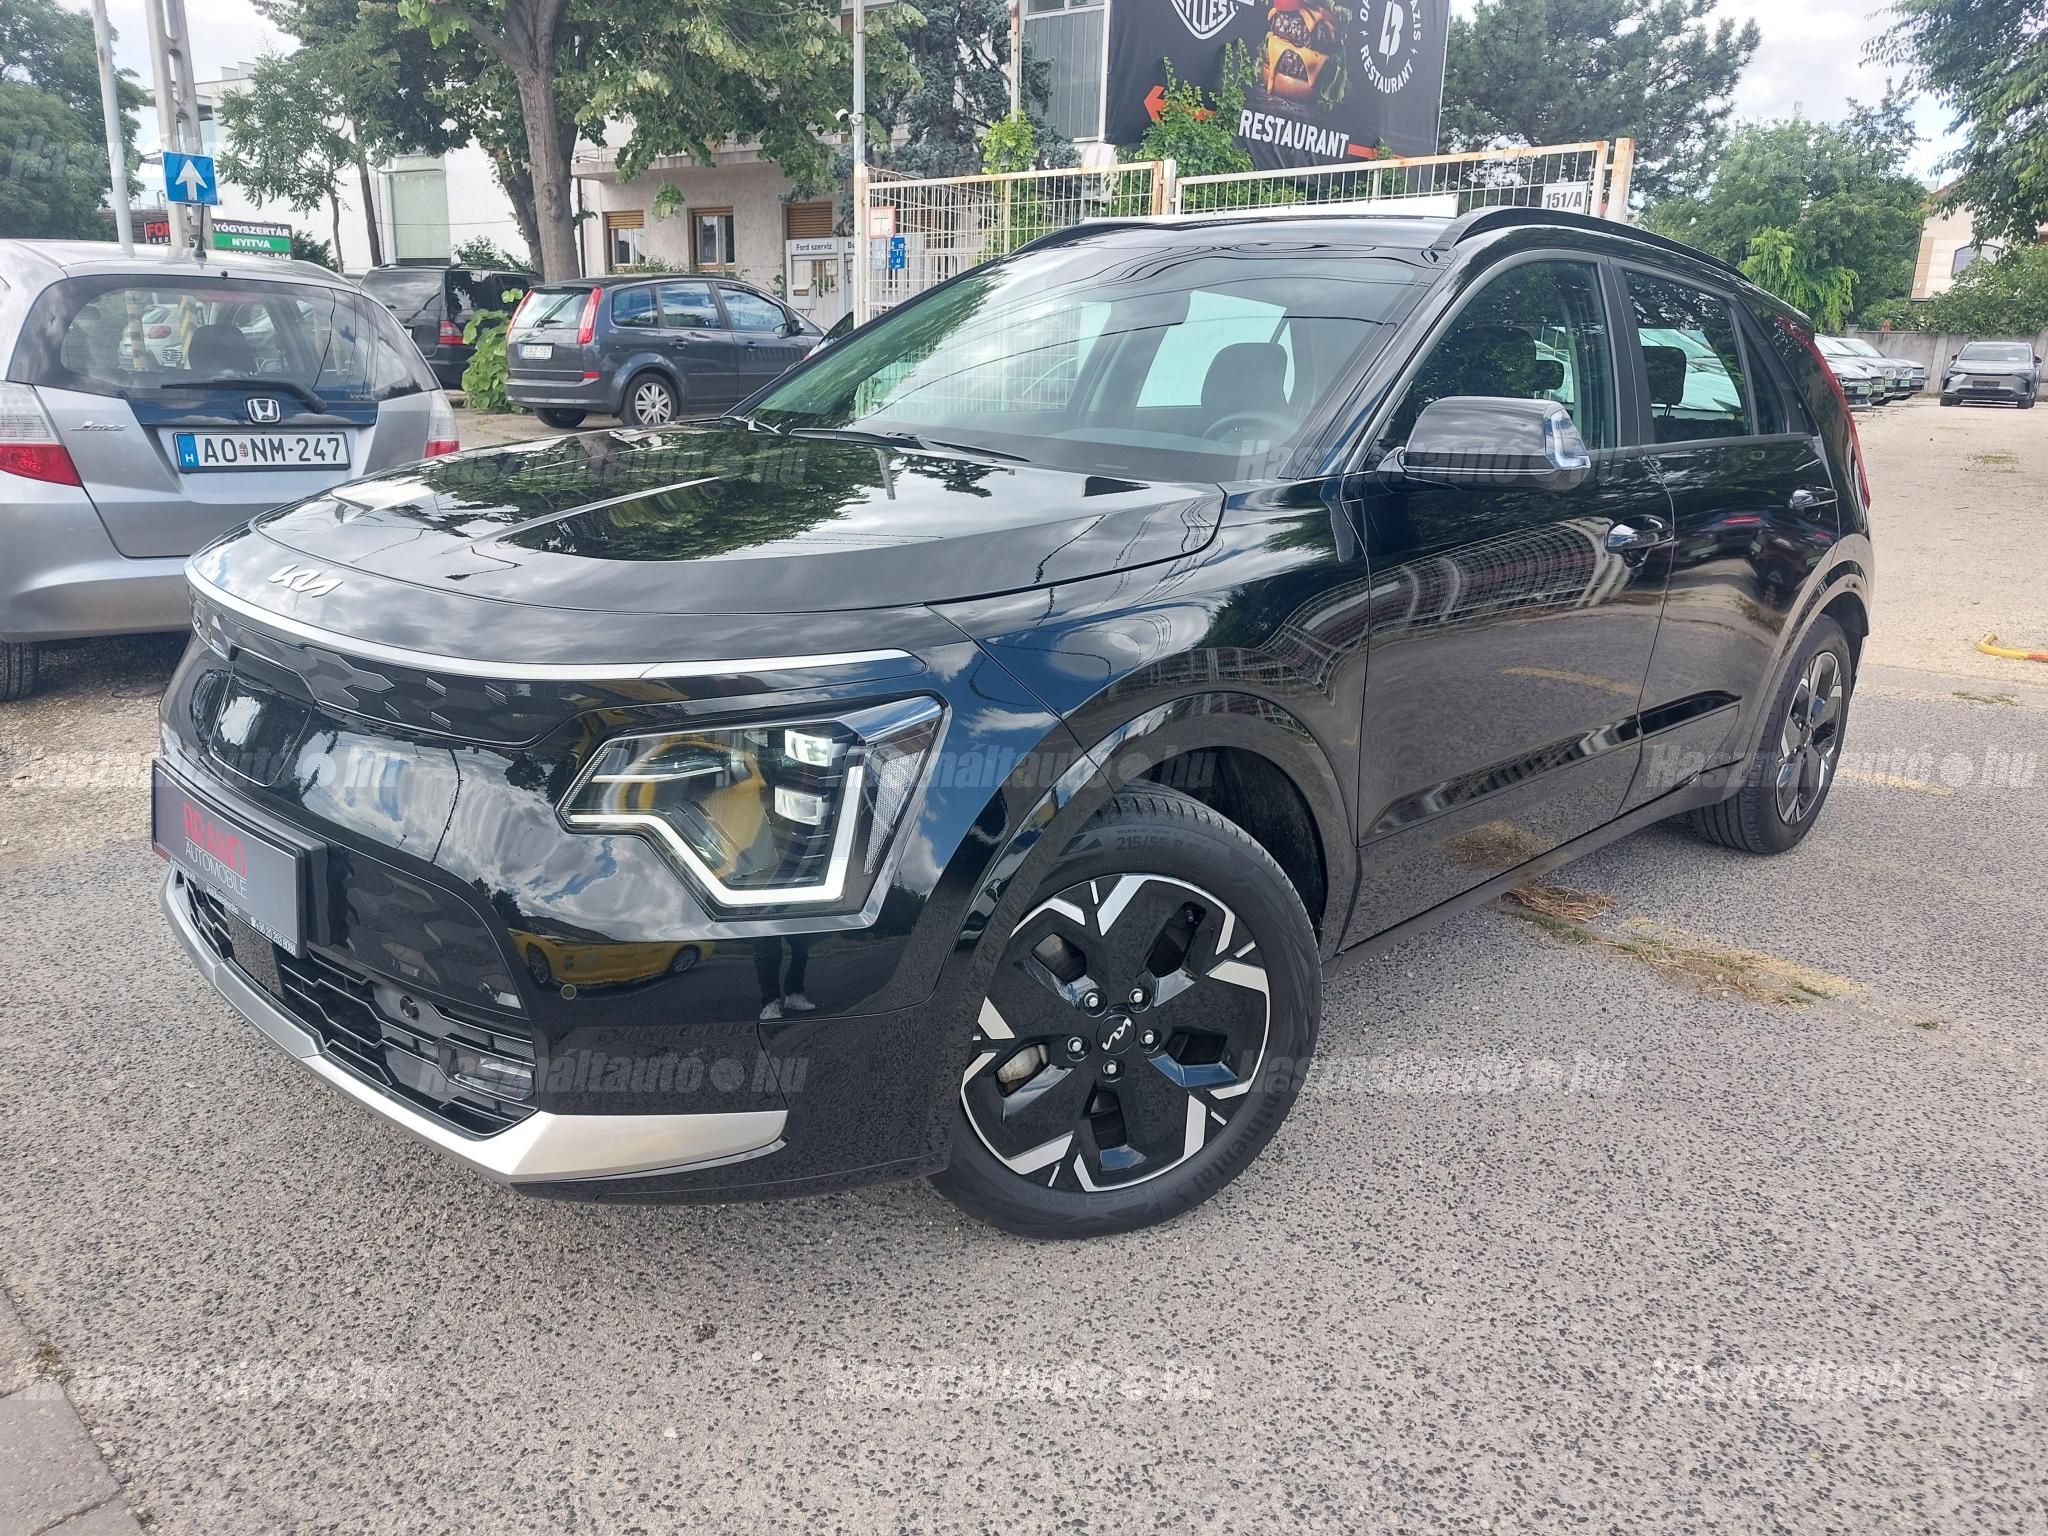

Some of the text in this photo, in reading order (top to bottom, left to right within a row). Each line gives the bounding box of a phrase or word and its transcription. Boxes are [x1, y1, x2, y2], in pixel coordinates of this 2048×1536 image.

[1360, 44, 1413, 94] RESTAURANT
[1239, 109, 1350, 159] RESTAURANT
[1546, 191, 1582, 209] 151/A
[231, 238, 271, 249] NYITVA
[796, 243, 810, 251] Ford
[69, 420, 128, 433] Jazz
[185, 437, 341, 464] H AO NM-247
[1116, 834, 1169, 851] 215/55
[185, 841, 248, 900] AUTOMOBILE
